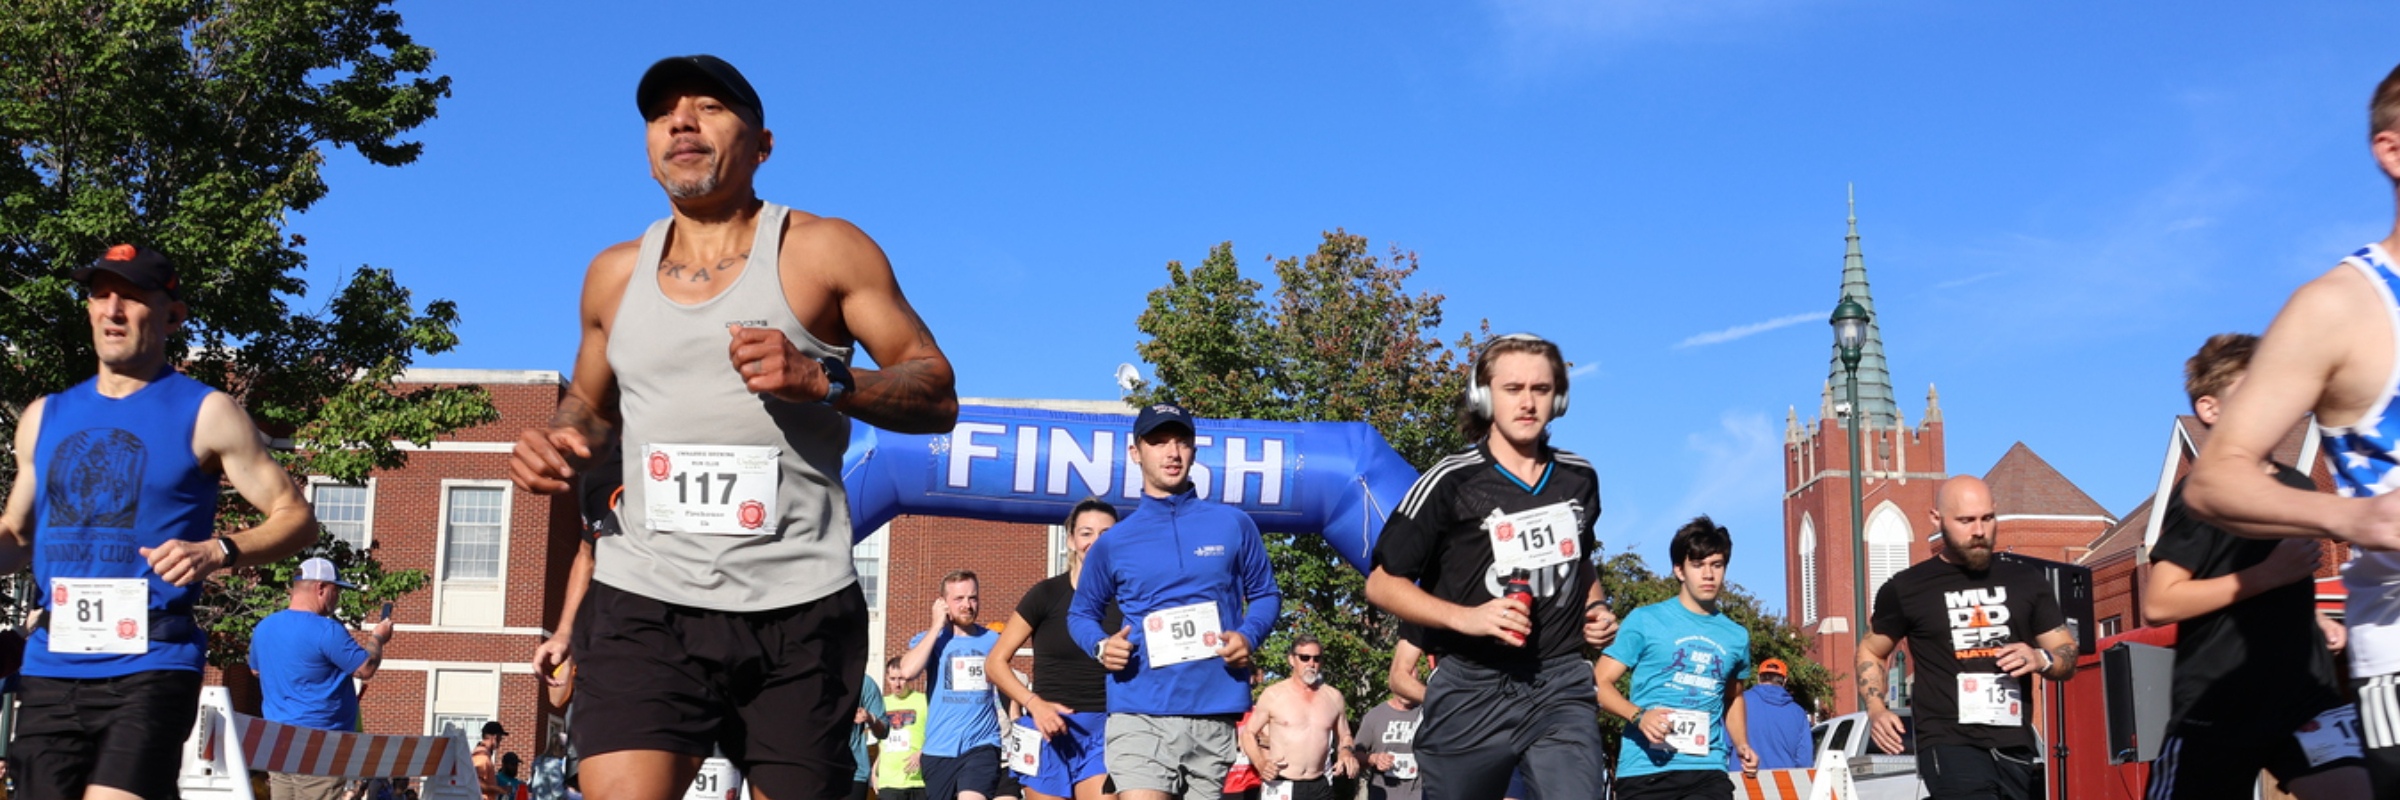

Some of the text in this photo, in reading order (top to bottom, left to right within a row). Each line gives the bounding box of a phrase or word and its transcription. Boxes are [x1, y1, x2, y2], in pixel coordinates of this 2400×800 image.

[674, 471, 737, 505] 117
[1517, 524, 1555, 552] 151
[77, 598, 104, 623] 81
[1171, 619, 1196, 640] 50
[968, 666, 983, 677] 95
[695, 773, 717, 792] 91
